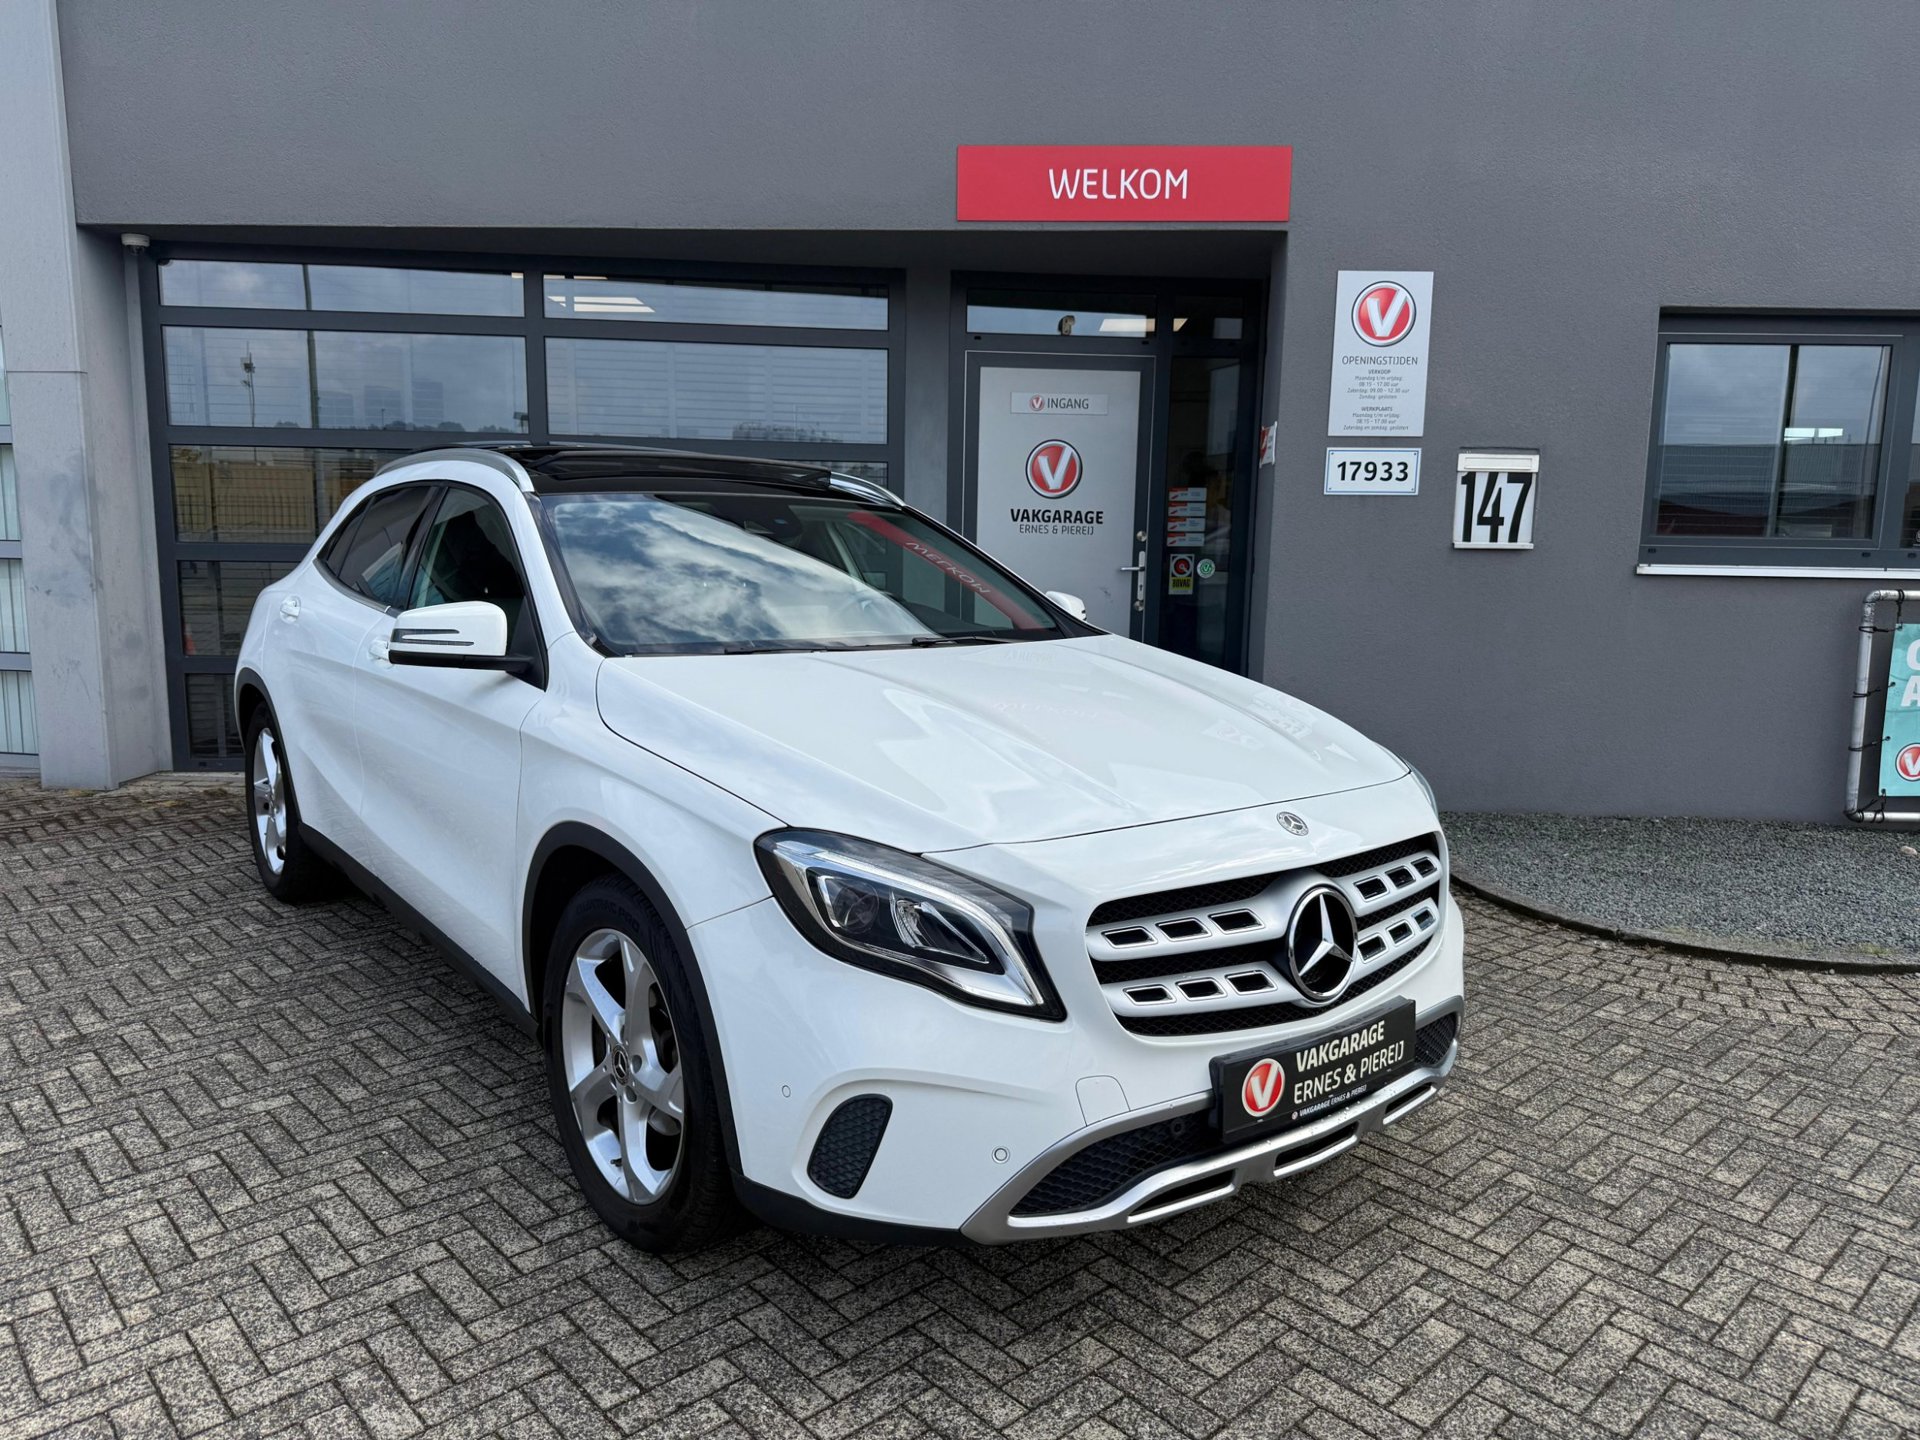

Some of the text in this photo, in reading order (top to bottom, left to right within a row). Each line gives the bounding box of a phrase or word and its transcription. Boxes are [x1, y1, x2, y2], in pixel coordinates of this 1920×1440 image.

[1048, 168, 1188, 200] WELKOM
[1342, 356, 1418, 365] OPENINGSTIJDEN
[1047, 398, 1089, 409] INGANG
[1337, 461, 1408, 482] 17933
[1010, 508, 1104, 524] VAKGARAGE
[1461, 472, 1532, 543] 147
[1019, 524, 1094, 536] ERNES & PIEREIJ
[1296, 1020, 1385, 1072] VAKGARAGE
[1294, 1068, 1342, 1104] ERNES
[1344, 1063, 1356, 1084] &
[1360, 1040, 1404, 1078] PIEREIJ
[1300, 1099, 1330, 1116] VAKGARAGE
[1331, 1093, 1346, 1105] ERNES
